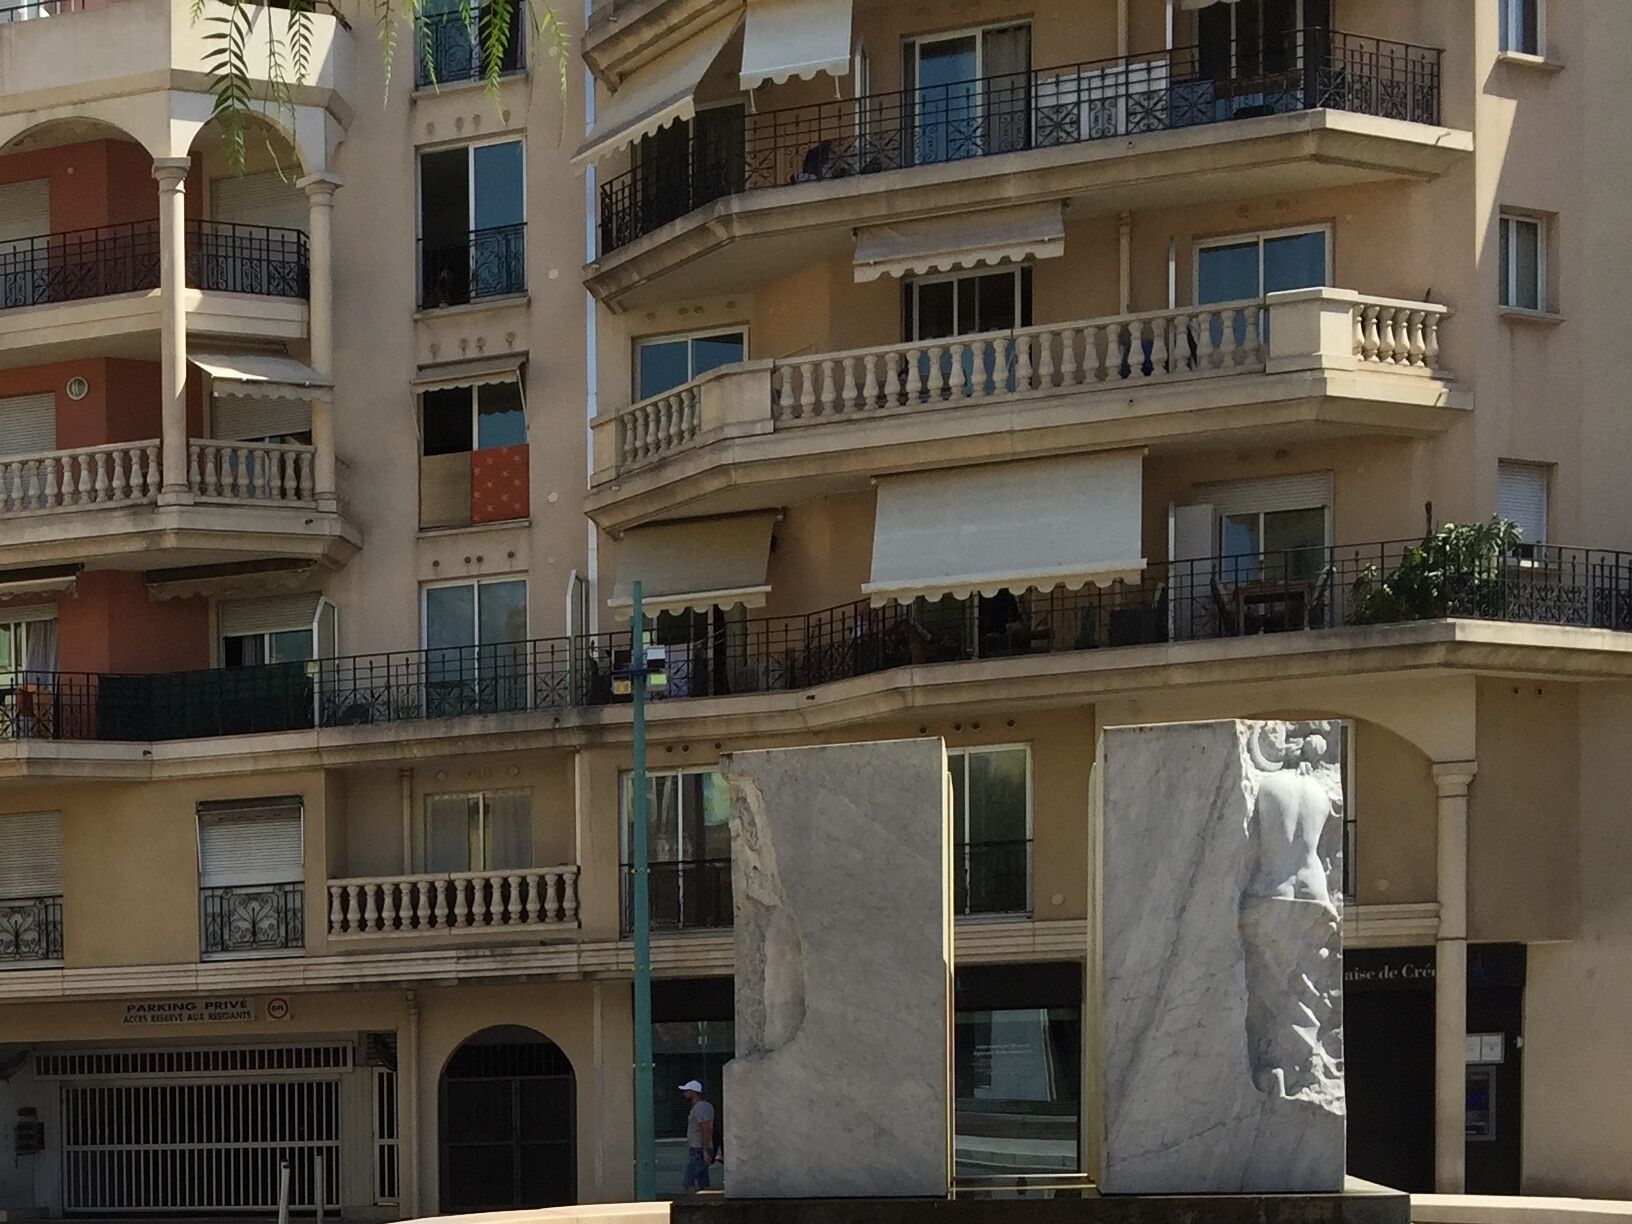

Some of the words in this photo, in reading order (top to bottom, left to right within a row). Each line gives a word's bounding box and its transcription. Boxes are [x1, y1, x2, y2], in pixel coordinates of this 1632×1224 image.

[1378, 964, 1399, 980] de
[126, 1002, 198, 1013] PARKING
[204, 997, 249, 1010] PRIVÉ
[186, 1012, 205, 1022] AUX
